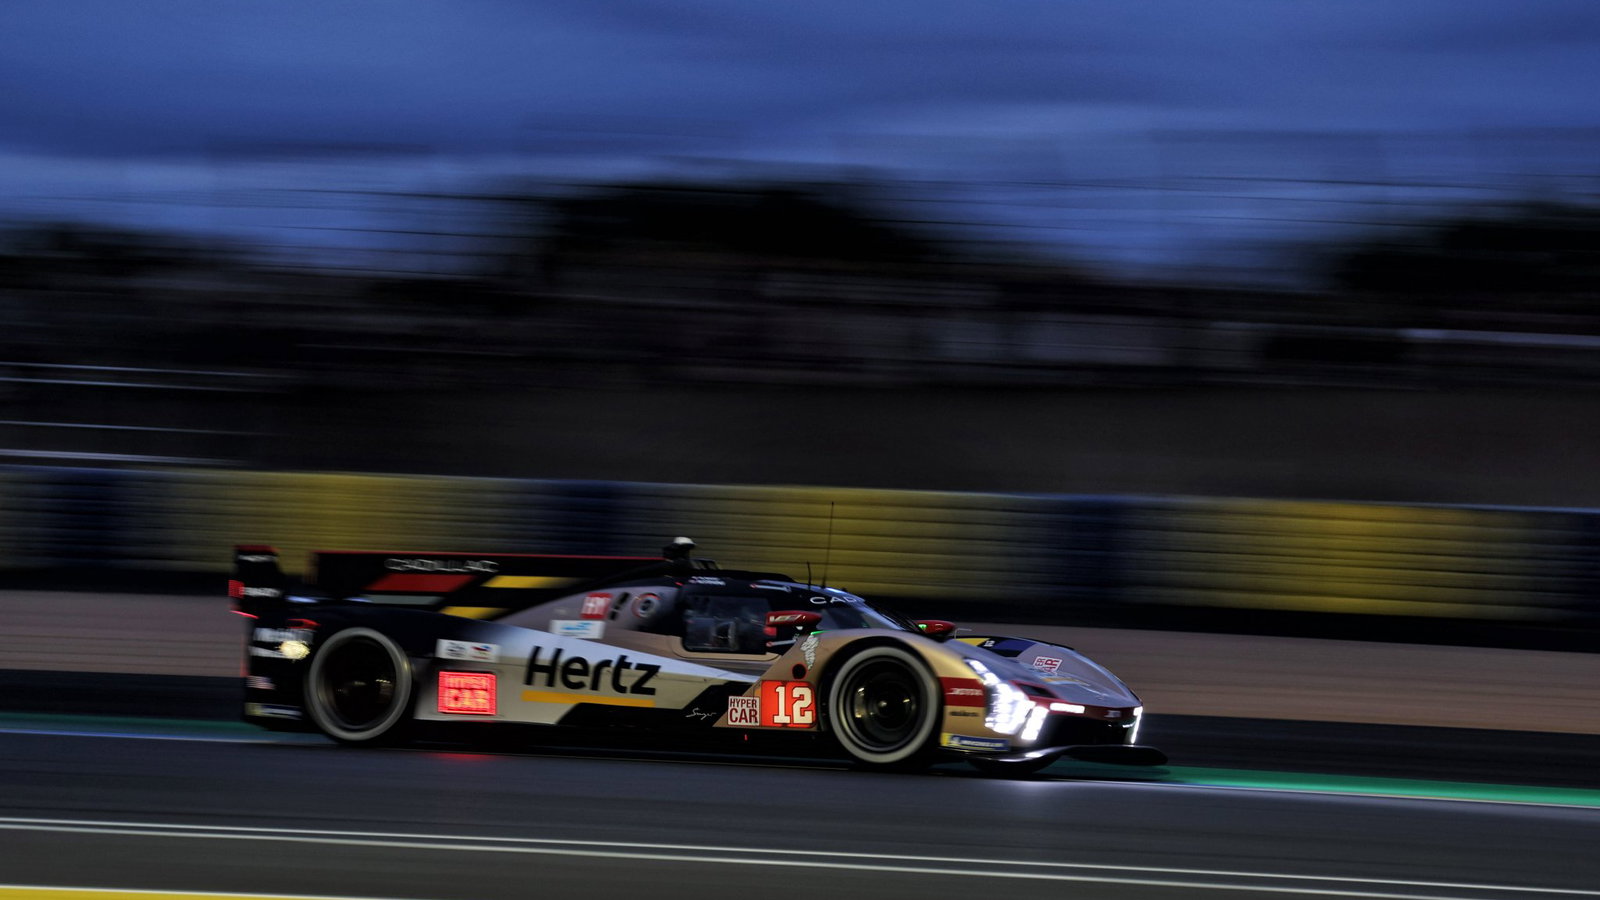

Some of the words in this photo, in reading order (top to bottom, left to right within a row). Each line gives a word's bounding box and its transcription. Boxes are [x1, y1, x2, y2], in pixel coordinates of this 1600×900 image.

[523, 645, 662, 696] Hertz
[728, 698, 758, 709] HYPER
[728, 708, 760, 724] CAR
[773, 685, 813, 725] 12
